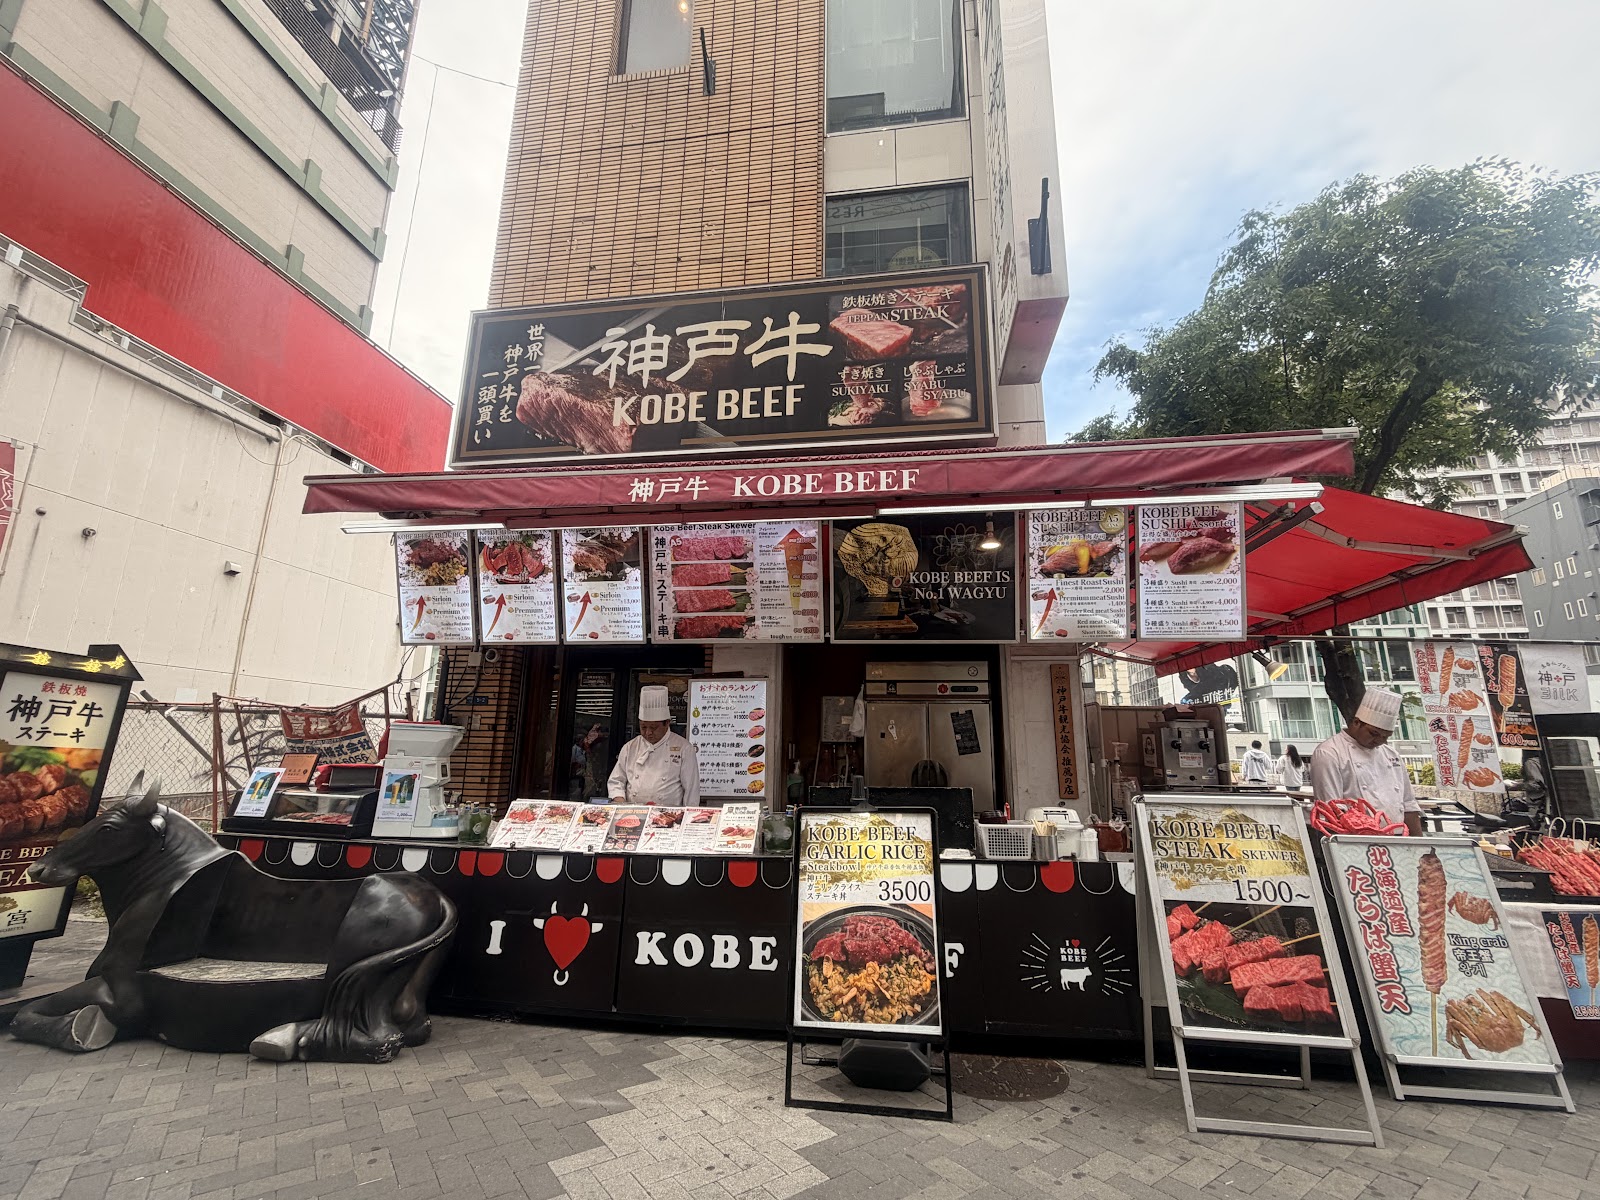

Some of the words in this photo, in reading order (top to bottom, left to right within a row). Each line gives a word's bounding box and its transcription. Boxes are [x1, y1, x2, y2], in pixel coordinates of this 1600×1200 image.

[841, 287, 956, 310] 鉄板焼きステーキ
[847, 311, 890, 325] TEPPAN
[890, 304, 950, 322] STEAK
[524, 323, 546, 374] 世界一
[594, 311, 834, 389] 神戸牛
[837, 366, 885, 380] すき焼き
[903, 362, 966, 377] しゃぶしゃぶ
[499, 344, 523, 424] 神戸牛を
[831, 384, 890, 397] SUKIYAKI
[903, 379, 947, 392] SYABU
[472, 372, 499, 446] 一頭買い
[612, 393, 708, 428] KOBE
[717, 384, 805, 421] BEEF
[627, 476, 710, 503] 神戸牛
[731, 473, 825, 498] KOBE
[831, 468, 921, 493] BEEF
[1032, 511, 1068, 523] KOBE
[1069, 510, 1106, 521] BEEF
[1106, 514, 1119, 523] A5
[1141, 507, 1180, 519] KOBE
[1181, 505, 1220, 517] BEEF
[724, 522, 756, 530] Skewer
[1032, 522, 1075, 534] SUSHI
[1141, 518, 1187, 530] SUSHI
[1190, 518, 1236, 529] Assorted
[670, 537, 683, 547] A5
[655, 536, 668, 575] 神戸牛
[909, 571, 950, 584] KOBE
[953, 570, 993, 583] BEEF
[995, 570, 1011, 583] IS
[1081, 578, 1102, 586] Roast
[600, 591, 621, 599] Sirloin
[914, 586, 944, 600] No.1
[947, 586, 1007, 600] WAGYU
[656, 579, 669, 638] ステーキ串
[699, 683, 759, 692] おすすめランキング
[6, 694, 104, 728] 神戸牛
[16, 726, 86, 744] ステーキ
[806, 826, 860, 842] KOBE
[867, 826, 917, 841] BEEF
[1152, 820, 1216, 839] KOBE
[1224, 822, 1282, 840] BEEF
[806, 845, 877, 860] GARLIC
[881, 844, 926, 859] RICE
[1156, 841, 1235, 860] STEAK
[1242, 849, 1299, 861] SKEWER
[1160, 862, 1190, 872] 神戸牛
[1194, 864, 1247, 875] ステーキ串
[806, 874, 831, 883] 神戸牛
[806, 883, 861, 892] ガーリックライス
[878, 880, 931, 902] 3500
[1367, 844, 1415, 937] 北海道産
[806, 892, 847, 901] ステーキ丼
[486, 920, 506, 956] I
[635, 931, 778, 973] KOBE
[1064, 939, 1071, 947] I
[1345, 865, 1412, 1015] たらば蟹天
[1448, 933, 1478, 949] King
[1479, 934, 1509, 949] crab
[1060, 947, 1087, 955] KOBE
[1060, 954, 1087, 962] BEEF
[1451, 949, 1495, 964] 帝王蟹
[1458, 962, 1489, 978] 왕게
